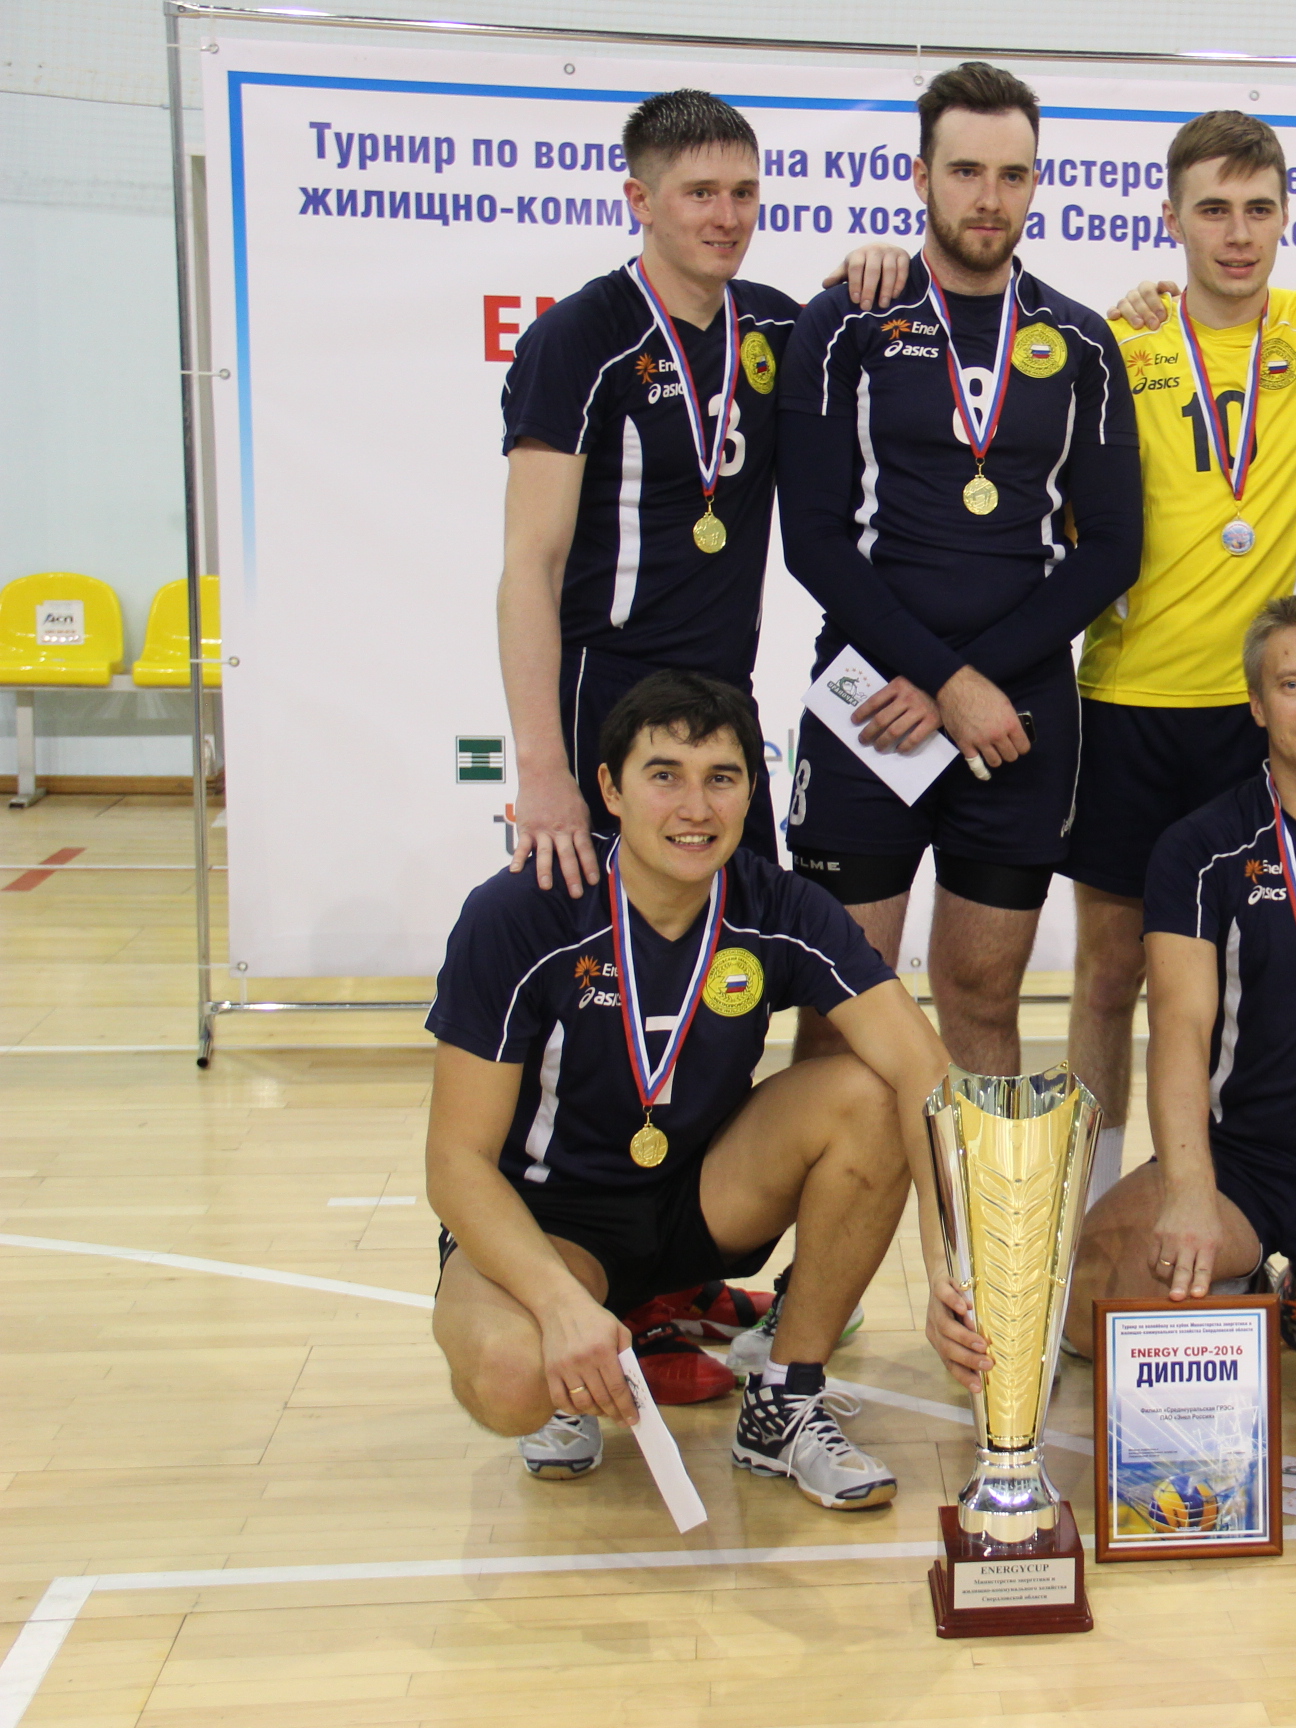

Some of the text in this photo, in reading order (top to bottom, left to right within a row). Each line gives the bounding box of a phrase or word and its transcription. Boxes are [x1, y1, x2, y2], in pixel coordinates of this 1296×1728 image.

[309, 121, 456, 174] Турнир
[472, 138, 519, 169] по
[764, 148, 809, 178] на
[825, 144, 916, 188] кубо
[1036, 158, 1168, 197] истерс
[911, 320, 940, 336] Enel
[902, 344, 940, 359] asics
[1154, 352, 1179, 366] Enel
[663, 383, 685, 398] asic
[1147, 376, 1180, 390] asics
[953, 366, 998, 446] 8
[708, 393, 746, 477] 3
[1181, 389, 1258, 473] 10
[789, 758, 812, 826] 8
[794, 855, 841, 872] ELME
[1131, 1345, 1244, 1358] ENERGY CUP-2016
[1136, 1359, 1239, 1388] ДИПЛОМ
[980, 1564, 1050, 1575] ENERGYCUP
